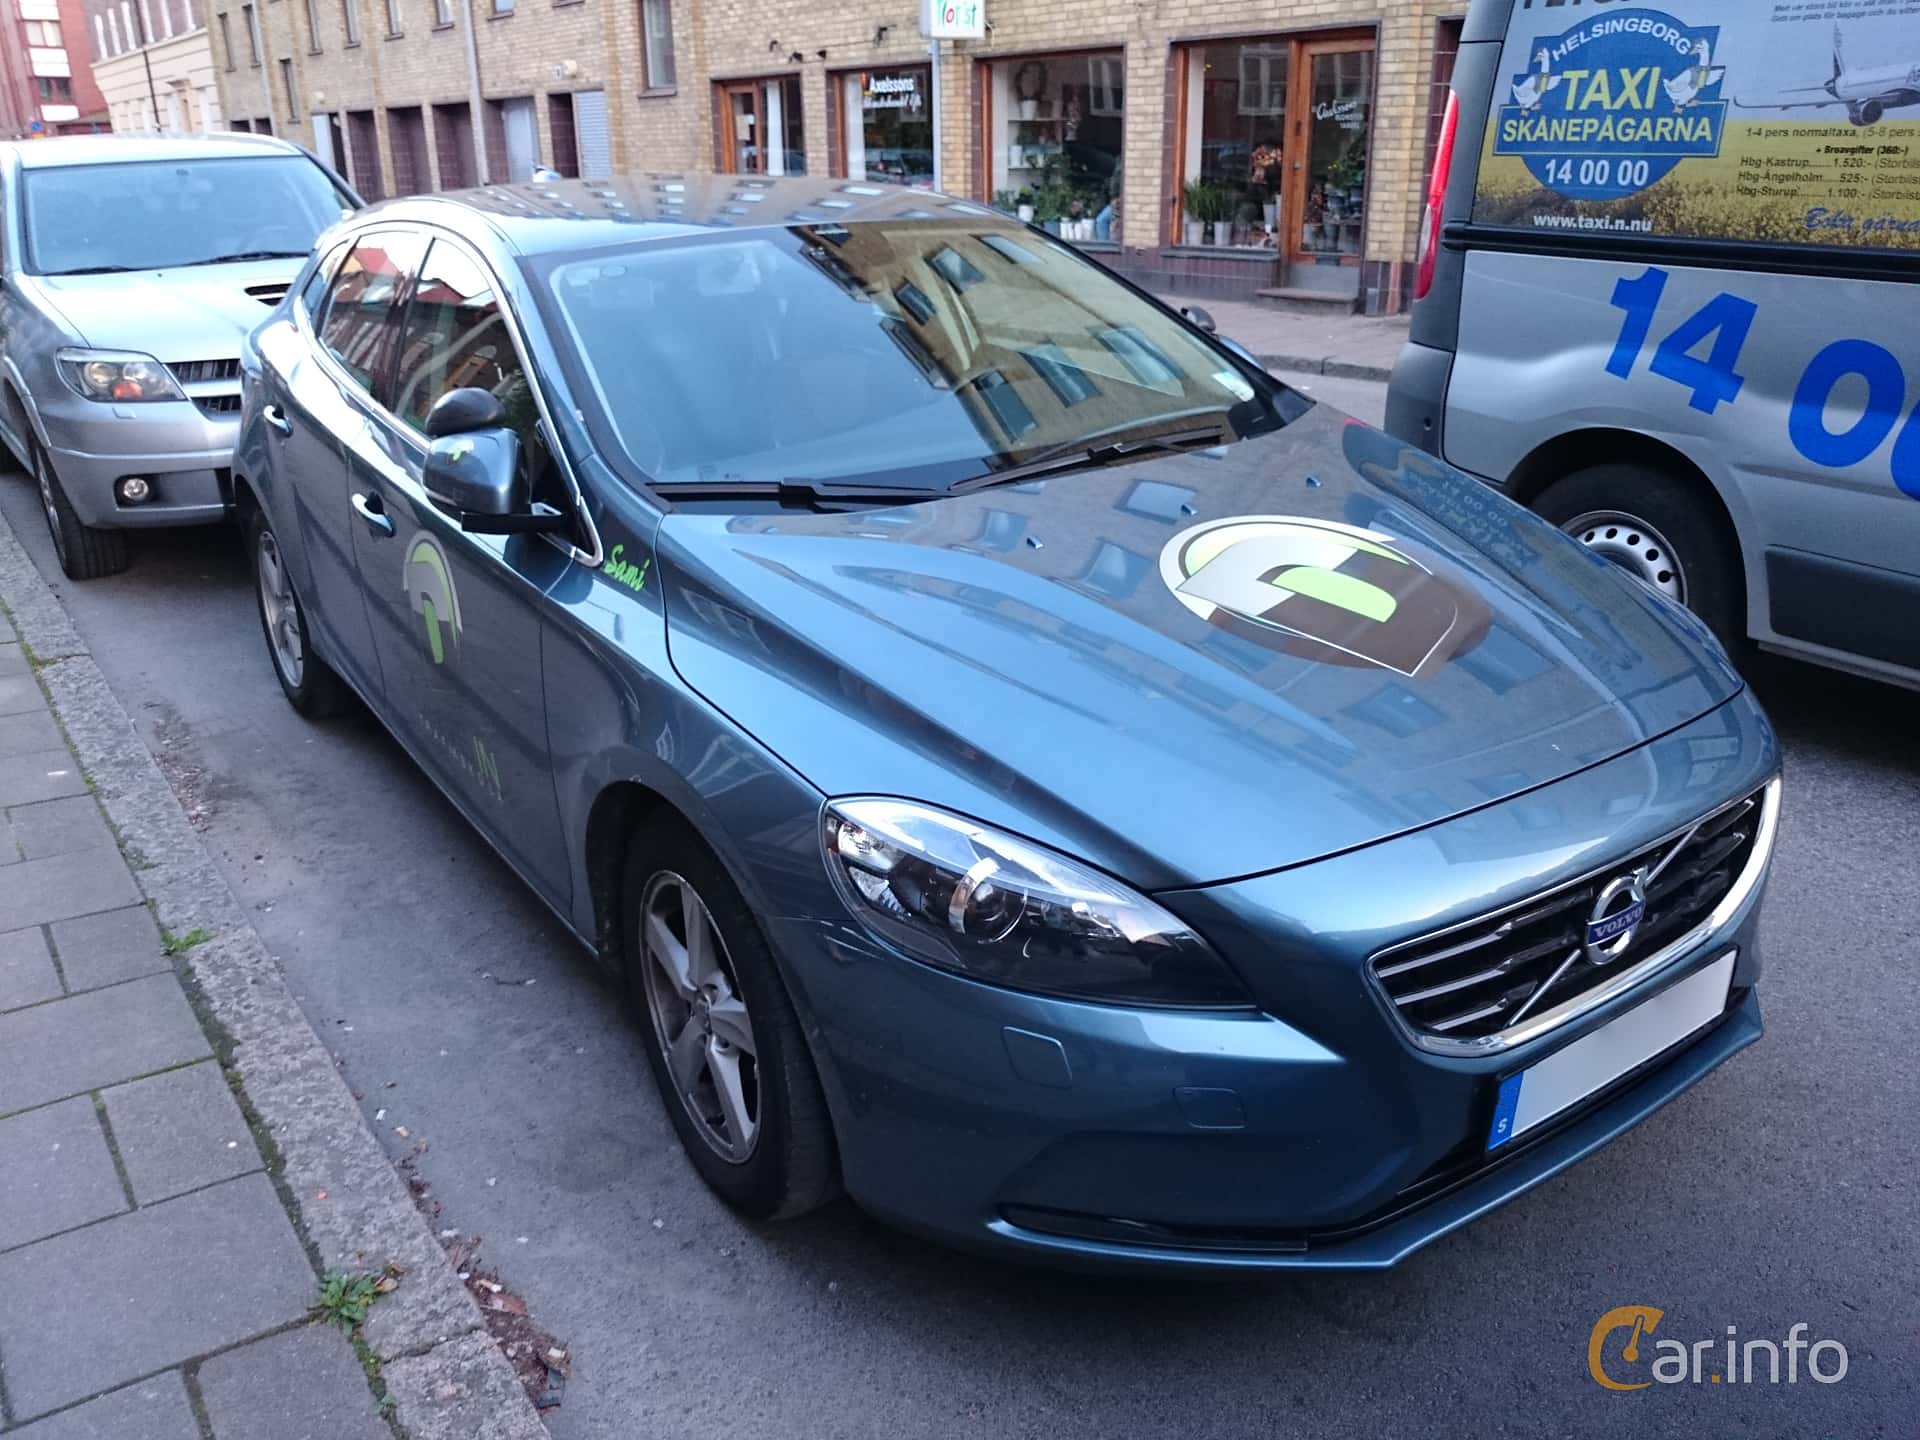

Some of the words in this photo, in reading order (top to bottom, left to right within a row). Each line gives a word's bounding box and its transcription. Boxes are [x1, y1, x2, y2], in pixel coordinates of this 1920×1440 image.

[1551, 18, 1692, 62] HELSINGBORG
[1562, 66, 1662, 111] TAXI
[1502, 114, 1713, 142] SKÅNEPÅGARNA
[1765, 128, 1789, 139] pers
[1888, 128, 1915, 139] pers
[1545, 159, 1572, 184] 14
[1579, 159, 1611, 185] 00
[1617, 160, 1649, 186] 00
[1533, 214, 1652, 232] www.taxi.n.nu
[1604, 266, 1758, 415] 14
[1788, 338, 1920, 502] 0
[1594, 906, 1642, 938] VOLVO
[1497, 1117, 1508, 1133] S
